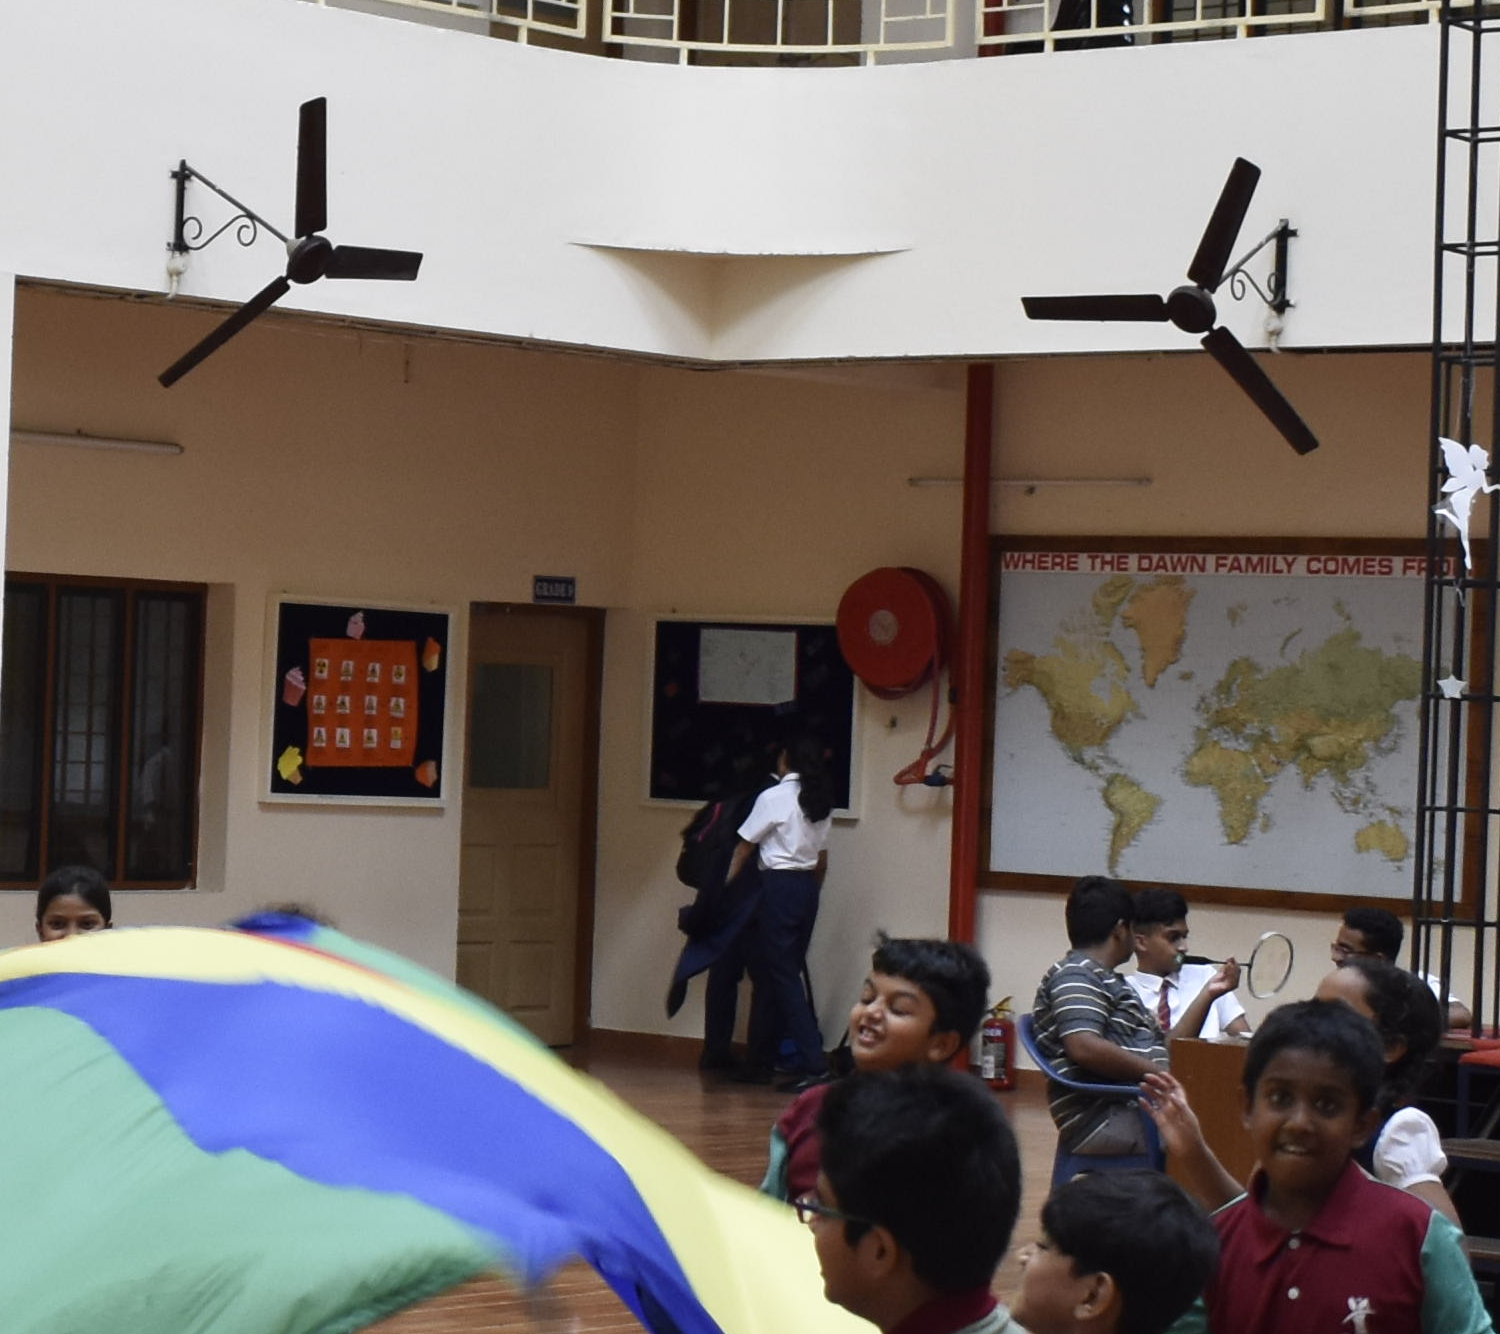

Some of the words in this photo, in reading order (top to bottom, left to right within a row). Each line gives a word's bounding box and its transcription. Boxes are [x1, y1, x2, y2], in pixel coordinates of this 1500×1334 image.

[1003, 553, 1079, 572] WHERE
[1087, 554, 1129, 572] THE
[1137, 555, 1206, 573] DAWN
[1214, 556, 1297, 574] FAMILY
[1306, 557, 1393, 576] COMES
[1402, 558, 1459, 576] FRO
